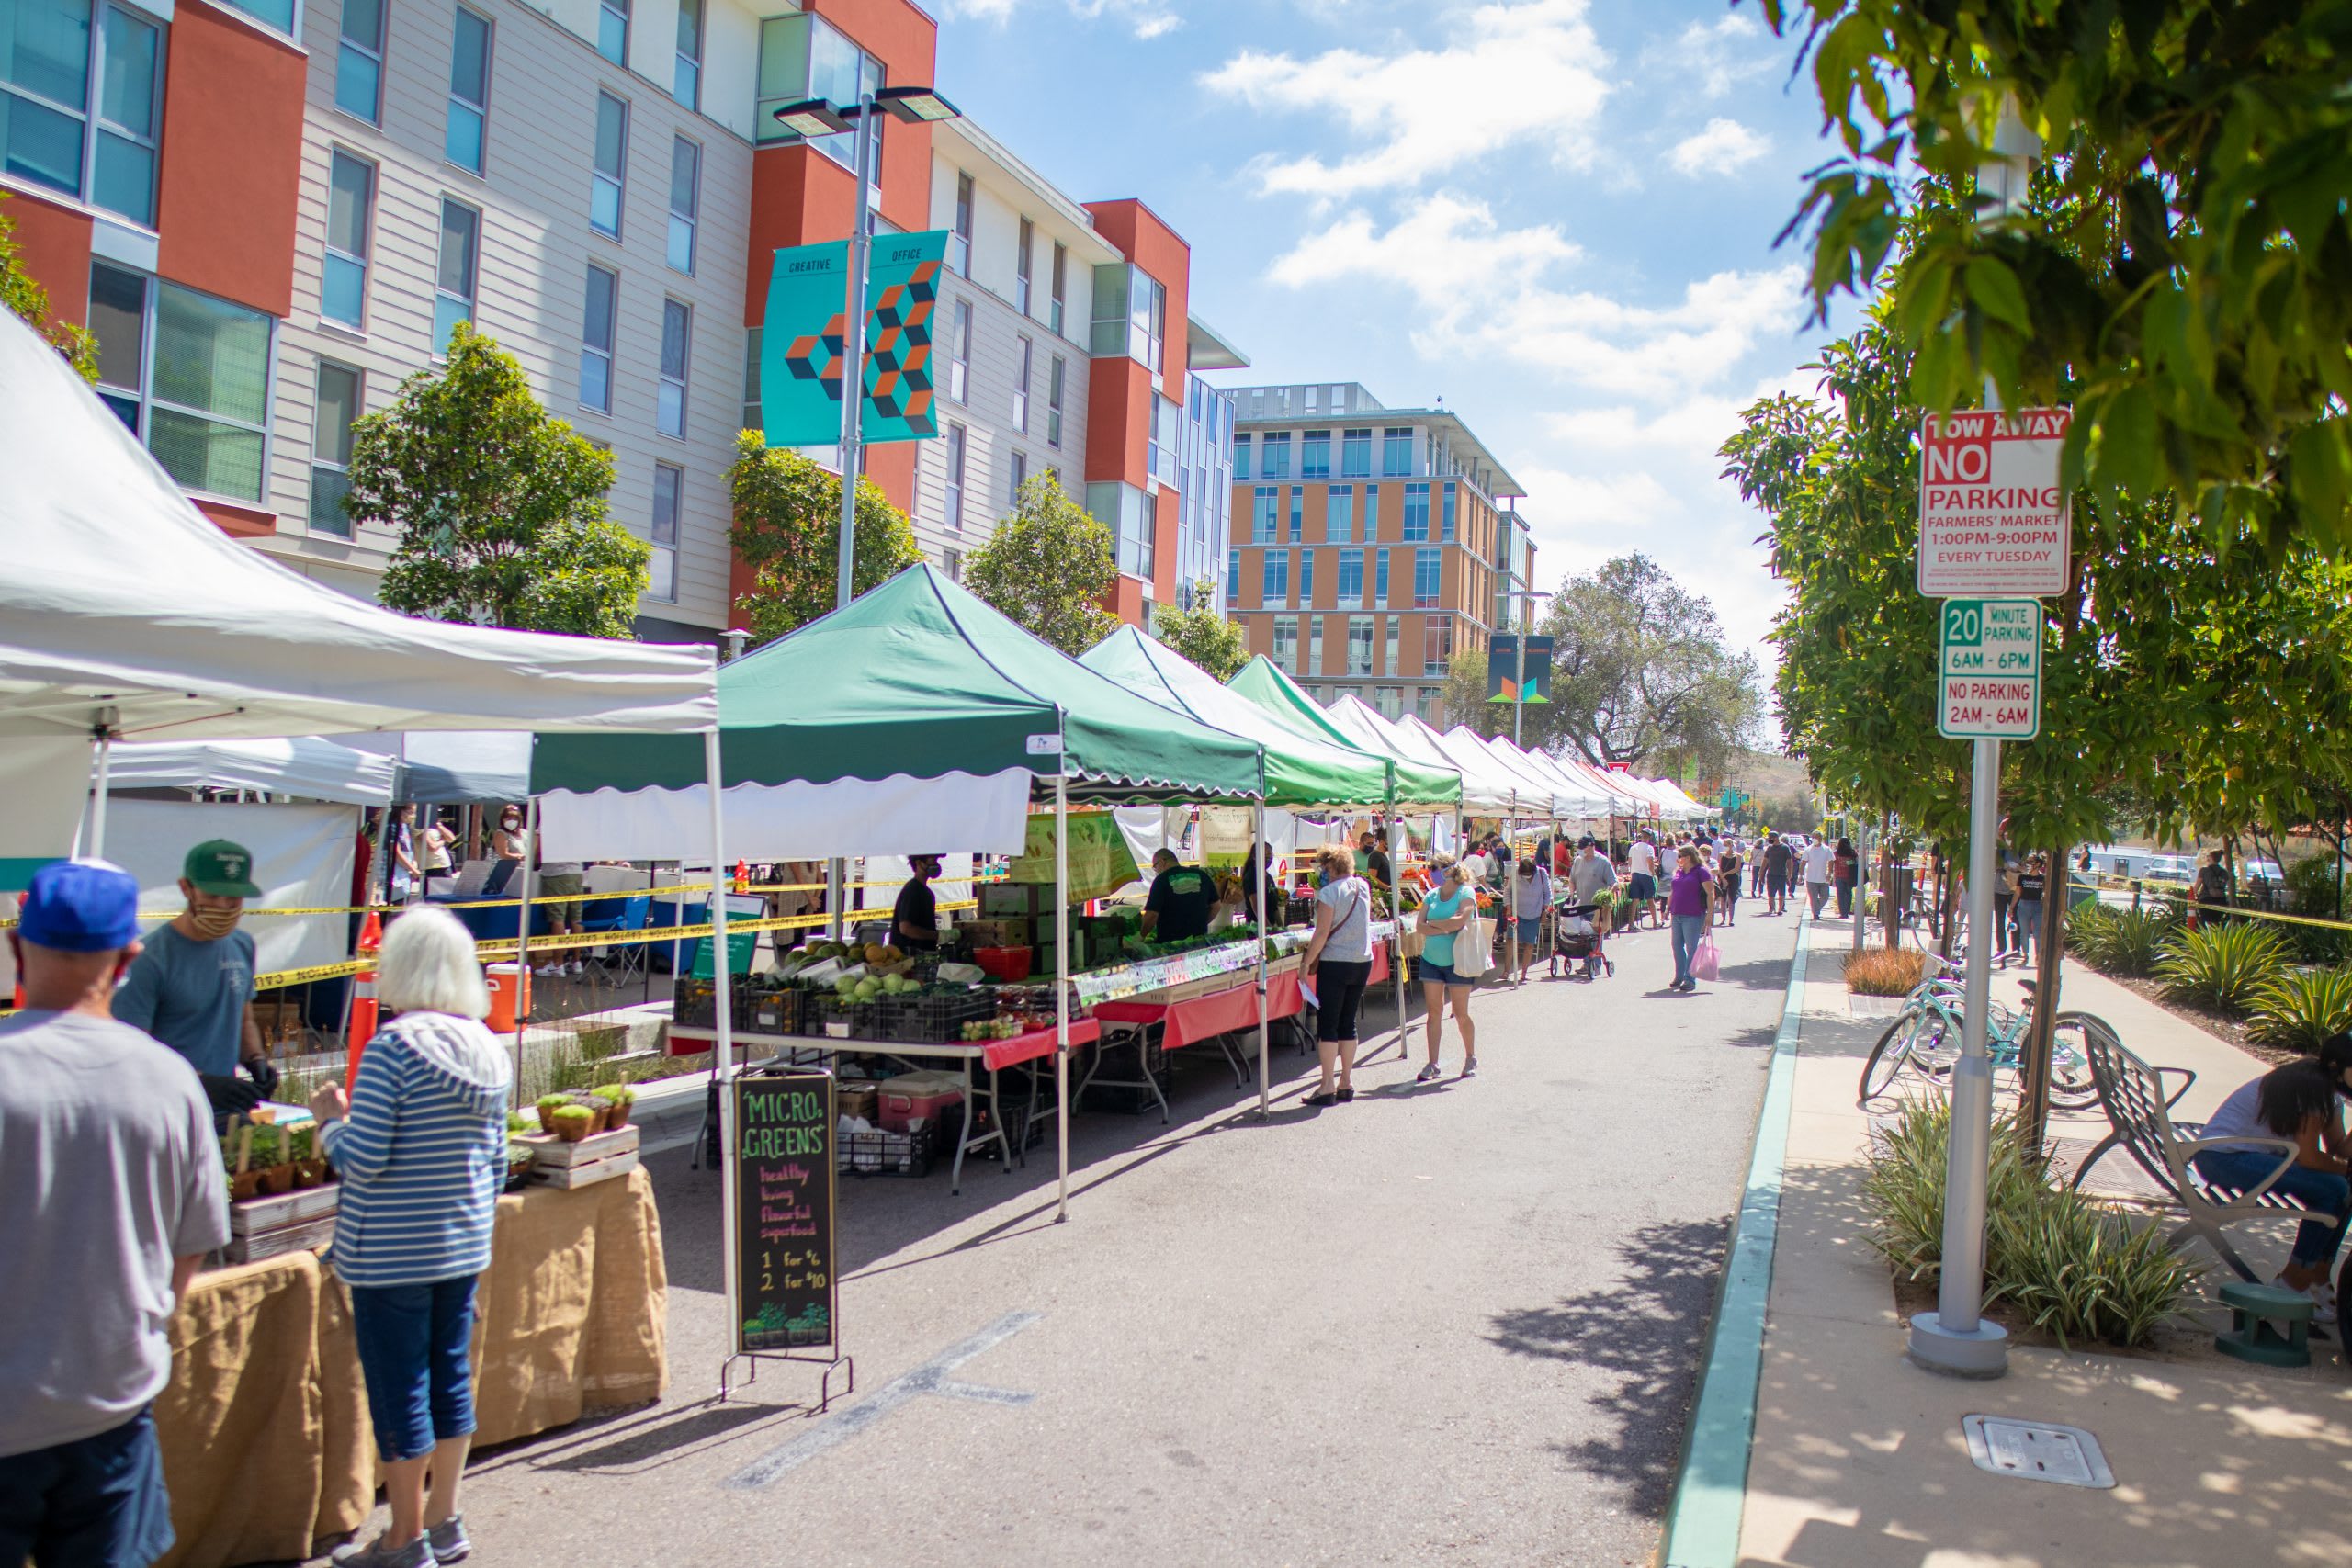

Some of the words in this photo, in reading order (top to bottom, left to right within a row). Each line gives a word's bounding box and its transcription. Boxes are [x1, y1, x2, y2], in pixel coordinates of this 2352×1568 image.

[788, 258, 831, 273] CREATIVE
[892, 248, 922, 262] OFFICE
[1928, 418, 1985, 439] TOW
[1992, 416, 2066, 437] AWAY
[1928, 444, 1988, 481] NO
[1928, 487, 2061, 510] PARKING
[2000, 515, 2061, 527] MARKET
[1931, 531, 2058, 545] 1:00PM-9:00PM
[1938, 551, 1981, 563] EVERY
[1986, 550, 2052, 562] TUESDAY
[1948, 609, 1979, 641] 20
[1990, 609, 2028, 624] MINUTE
[1984, 627, 2033, 642] PARKING
[1951, 652, 1984, 669] 6AM
[1998, 652, 2030, 669] 6PM
[1948, 682, 1967, 700] NO
[1971, 683, 2030, 701] PARKING
[1950, 706, 1982, 723] 2AM
[1996, 707, 2028, 724] 6AM
[558, 934, 597, 945] CAUTION
[605, 931, 642, 942] CAUTION
[296, 962, 357, 981] CAUTION
[749, 1091, 819, 1123] MICRO
[744, 1126, 824, 1159] GREENS
[760, 1163, 809, 1187] healthy
[760, 1221, 817, 1244] superfood
[762, 1251, 773, 1269] 1
[784, 1251, 804, 1267] for
[760, 1272, 775, 1292] 2
[785, 1273, 805, 1290] for
